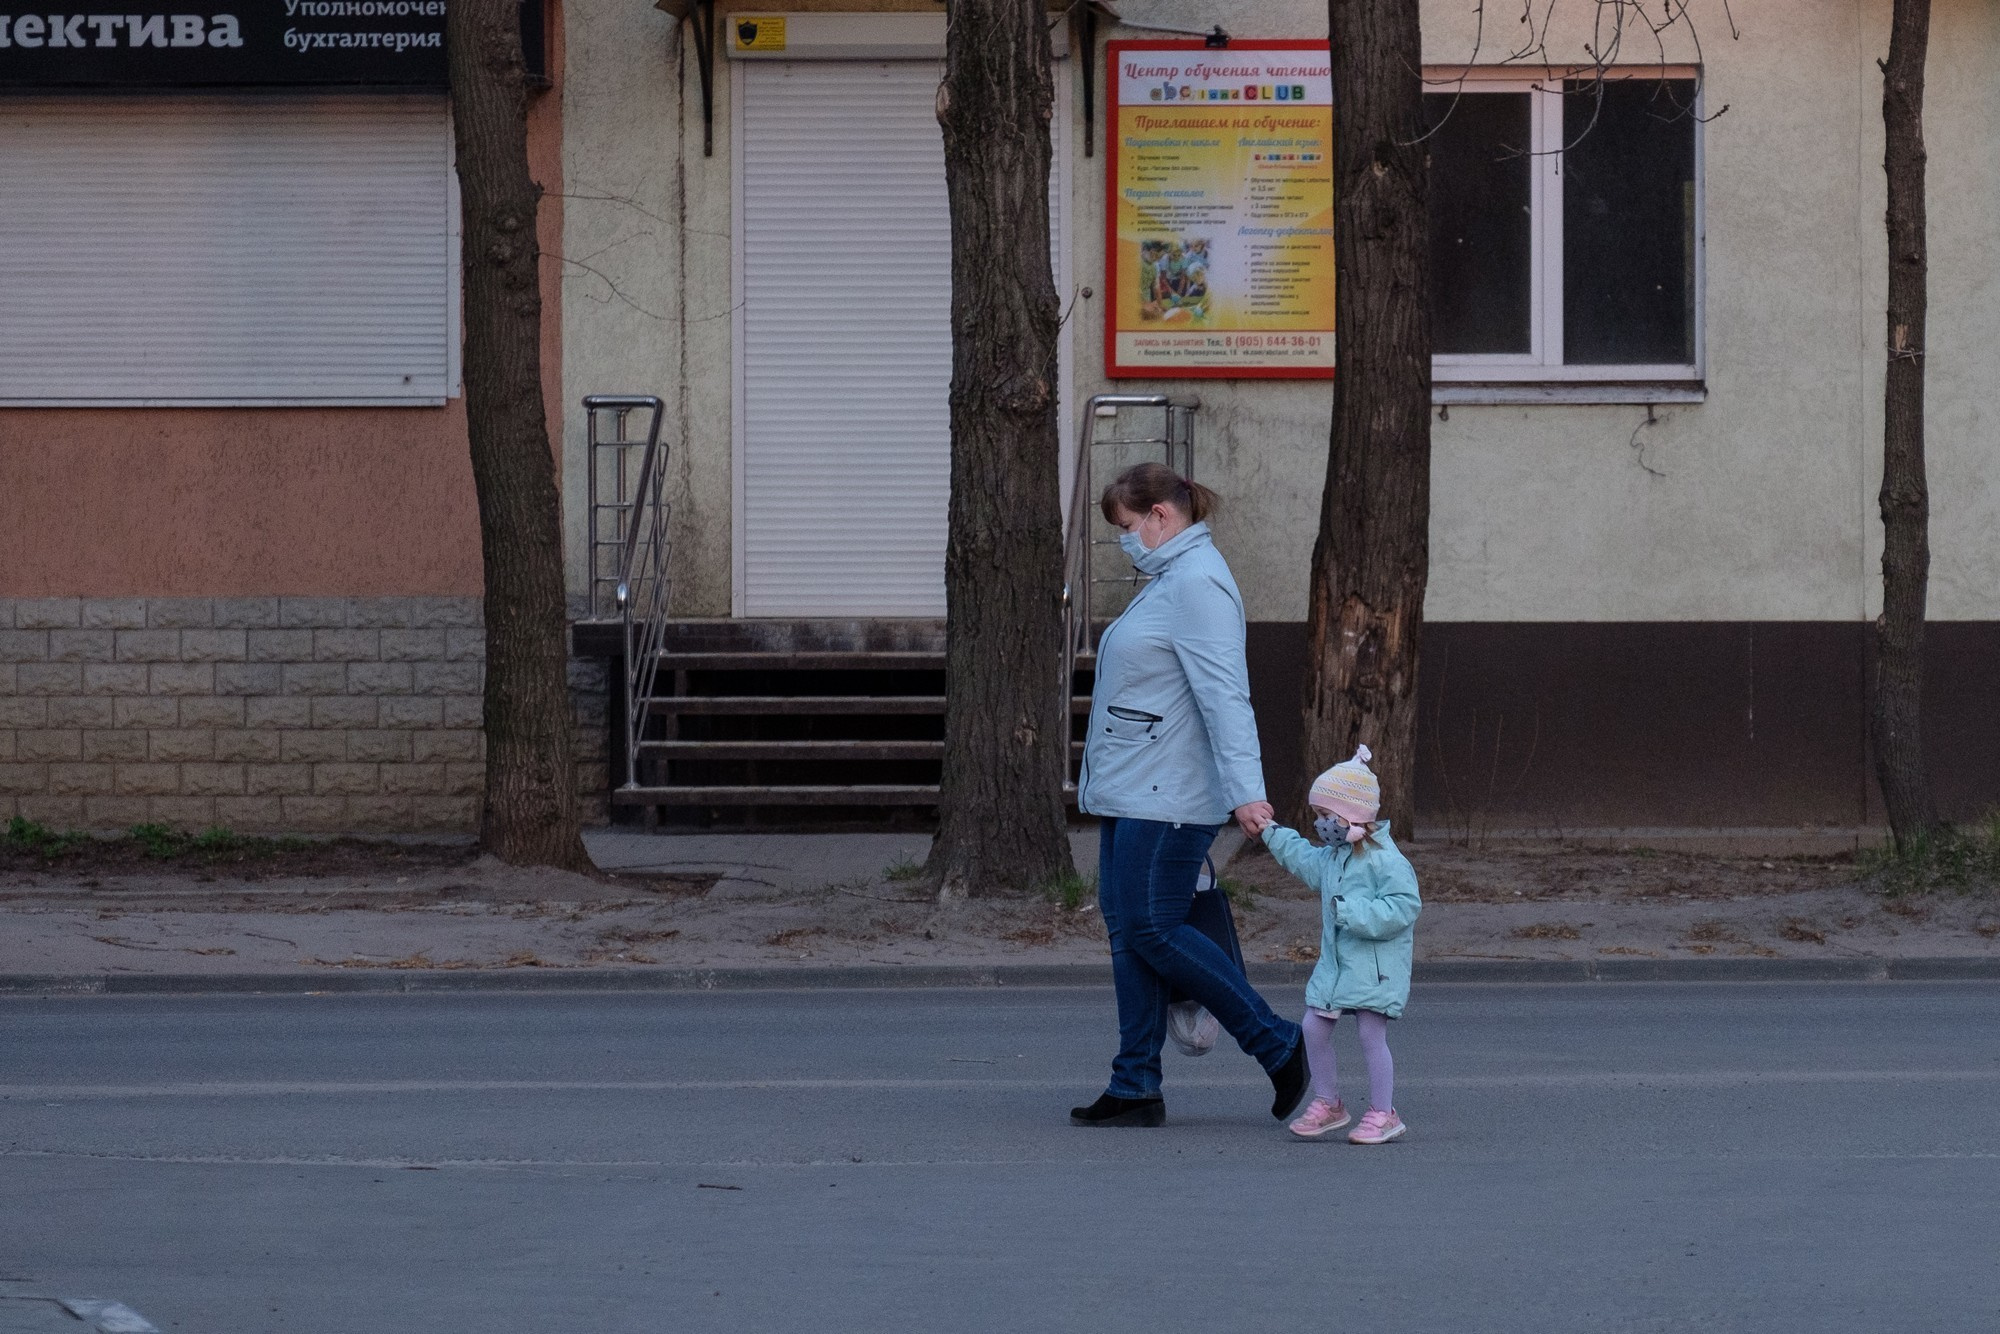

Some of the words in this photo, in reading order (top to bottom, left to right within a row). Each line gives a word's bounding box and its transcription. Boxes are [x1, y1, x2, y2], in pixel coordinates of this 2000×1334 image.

[283, 28, 442, 53] бухгалтерия
[1124, 63, 1179, 80] Центр
[1184, 63, 1261, 81] обучения
[1266, 66, 1332, 77] чтению
[1244, 85, 1305, 100] CLUB
[1134, 115, 1228, 131] Приглашаем
[1232, 118, 1250, 128] на
[1253, 115, 1321, 131] обучение:
[1225, 336, 1232, 347] 8
[1235, 335, 1264, 348] (905)
[1266, 335, 1321, 347] 644-36-01
